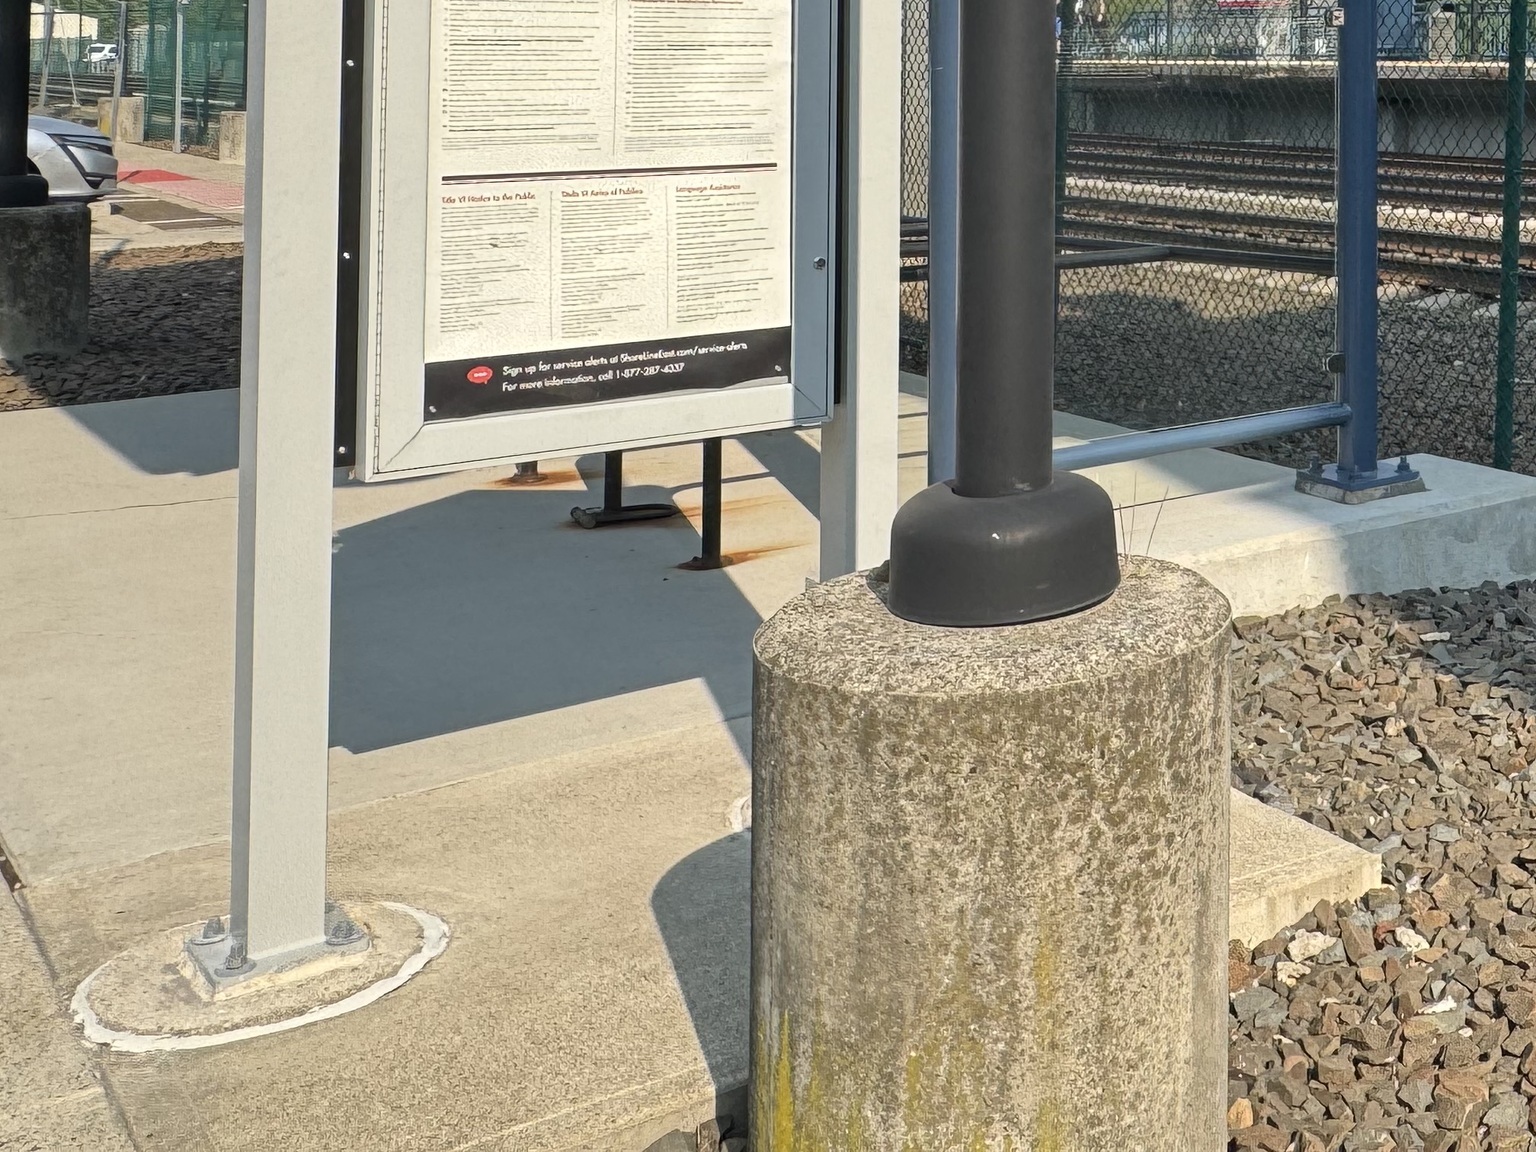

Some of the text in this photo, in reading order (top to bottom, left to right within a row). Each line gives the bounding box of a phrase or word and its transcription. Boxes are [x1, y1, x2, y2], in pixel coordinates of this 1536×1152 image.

[502, 365, 523, 377] Sign
[524, 365, 537, 375] up
[538, 360, 552, 372] for
[502, 381, 518, 392] For
[519, 380, 544, 390] more
[598, 369, 614, 381] call
